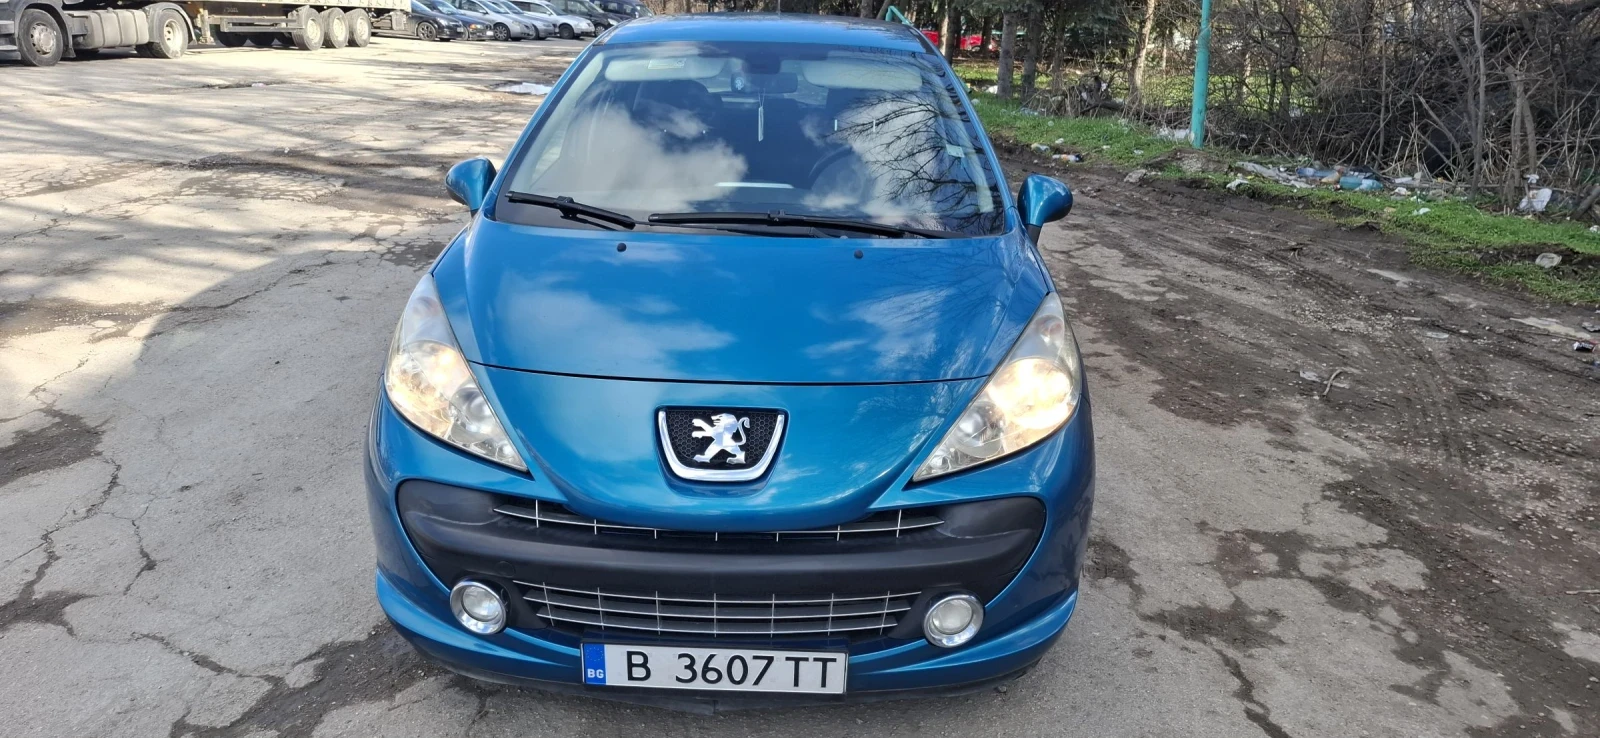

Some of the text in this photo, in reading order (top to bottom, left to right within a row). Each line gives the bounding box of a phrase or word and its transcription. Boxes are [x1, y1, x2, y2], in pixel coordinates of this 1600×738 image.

[587, 669, 604, 679] BG
[626, 650, 837, 688] B 3607 TT
